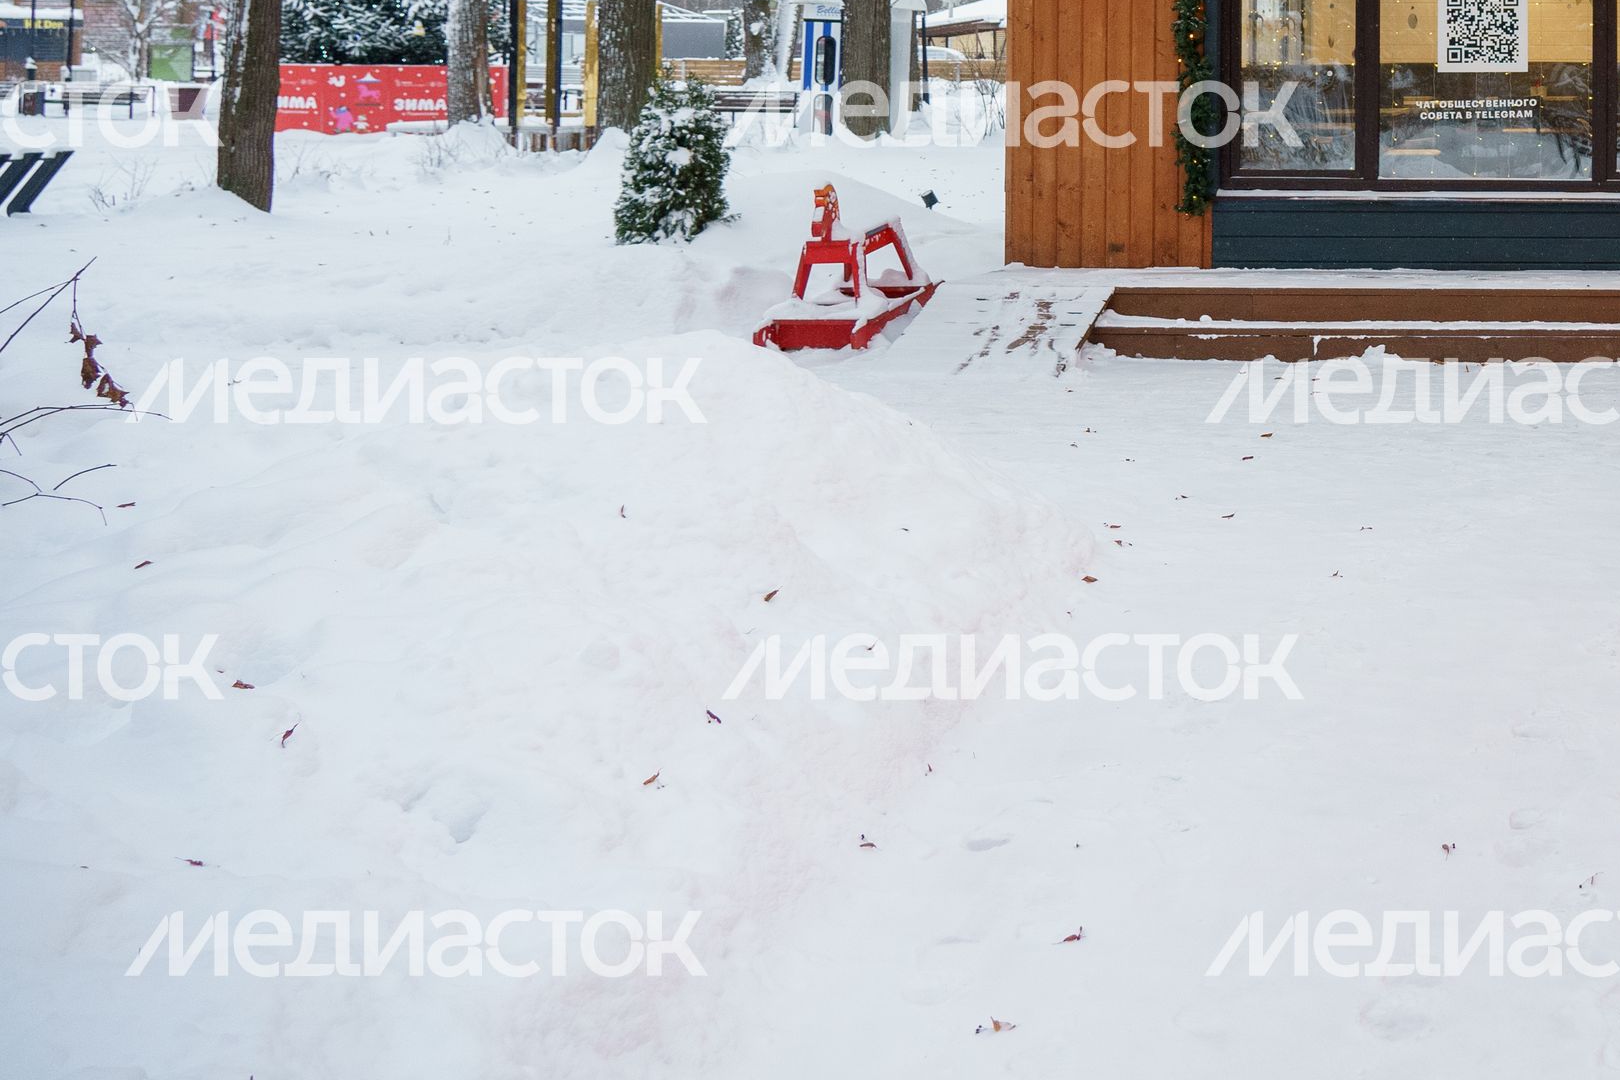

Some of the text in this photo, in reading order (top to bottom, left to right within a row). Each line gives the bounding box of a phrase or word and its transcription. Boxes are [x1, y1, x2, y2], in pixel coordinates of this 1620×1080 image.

[277, 95, 318, 109] ИМА
[1415, 98, 1538, 110] ЧАТ ОБЩЕСТВЕННОГО
[1420, 110, 1533, 120] СОВЕТА В TELEGRAM
